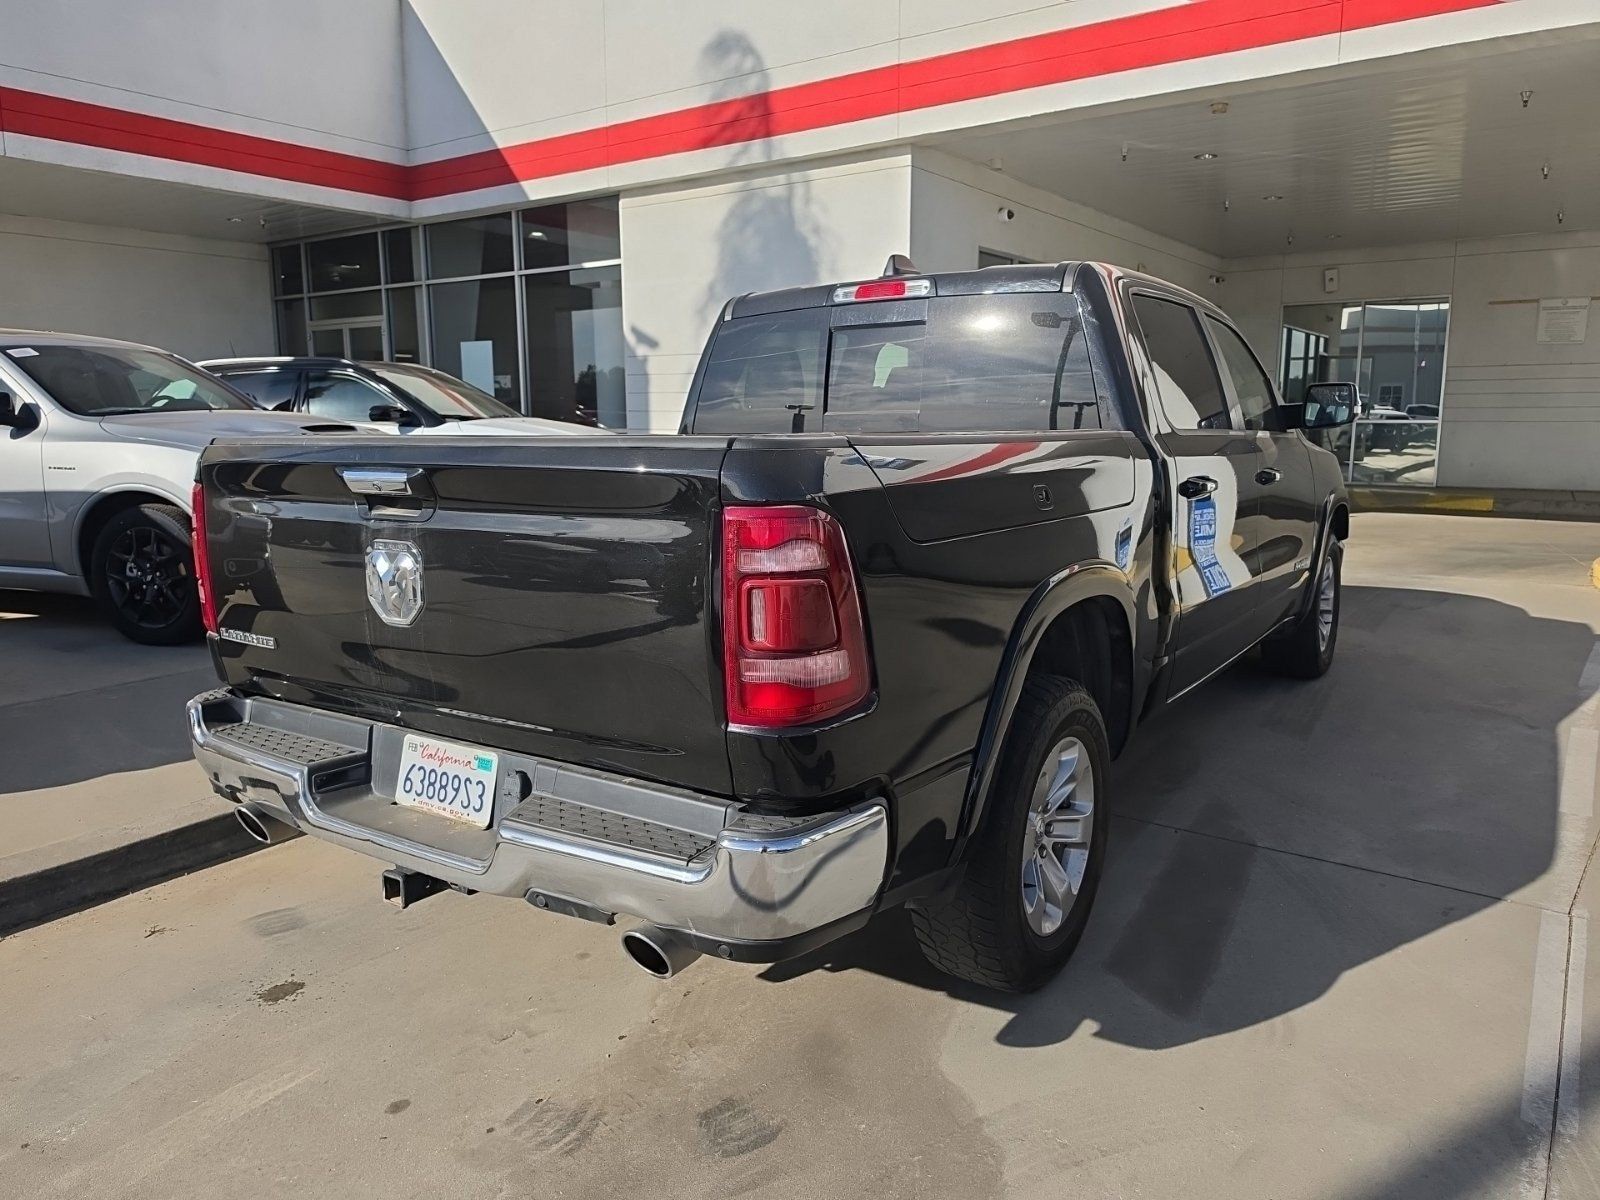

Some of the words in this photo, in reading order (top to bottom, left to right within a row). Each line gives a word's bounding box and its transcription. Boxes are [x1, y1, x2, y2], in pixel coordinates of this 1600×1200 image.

[420, 743, 478, 771] California
[403, 763, 486, 813] 63889S3
[418, 800, 466, 817] dmv.ca.gov
